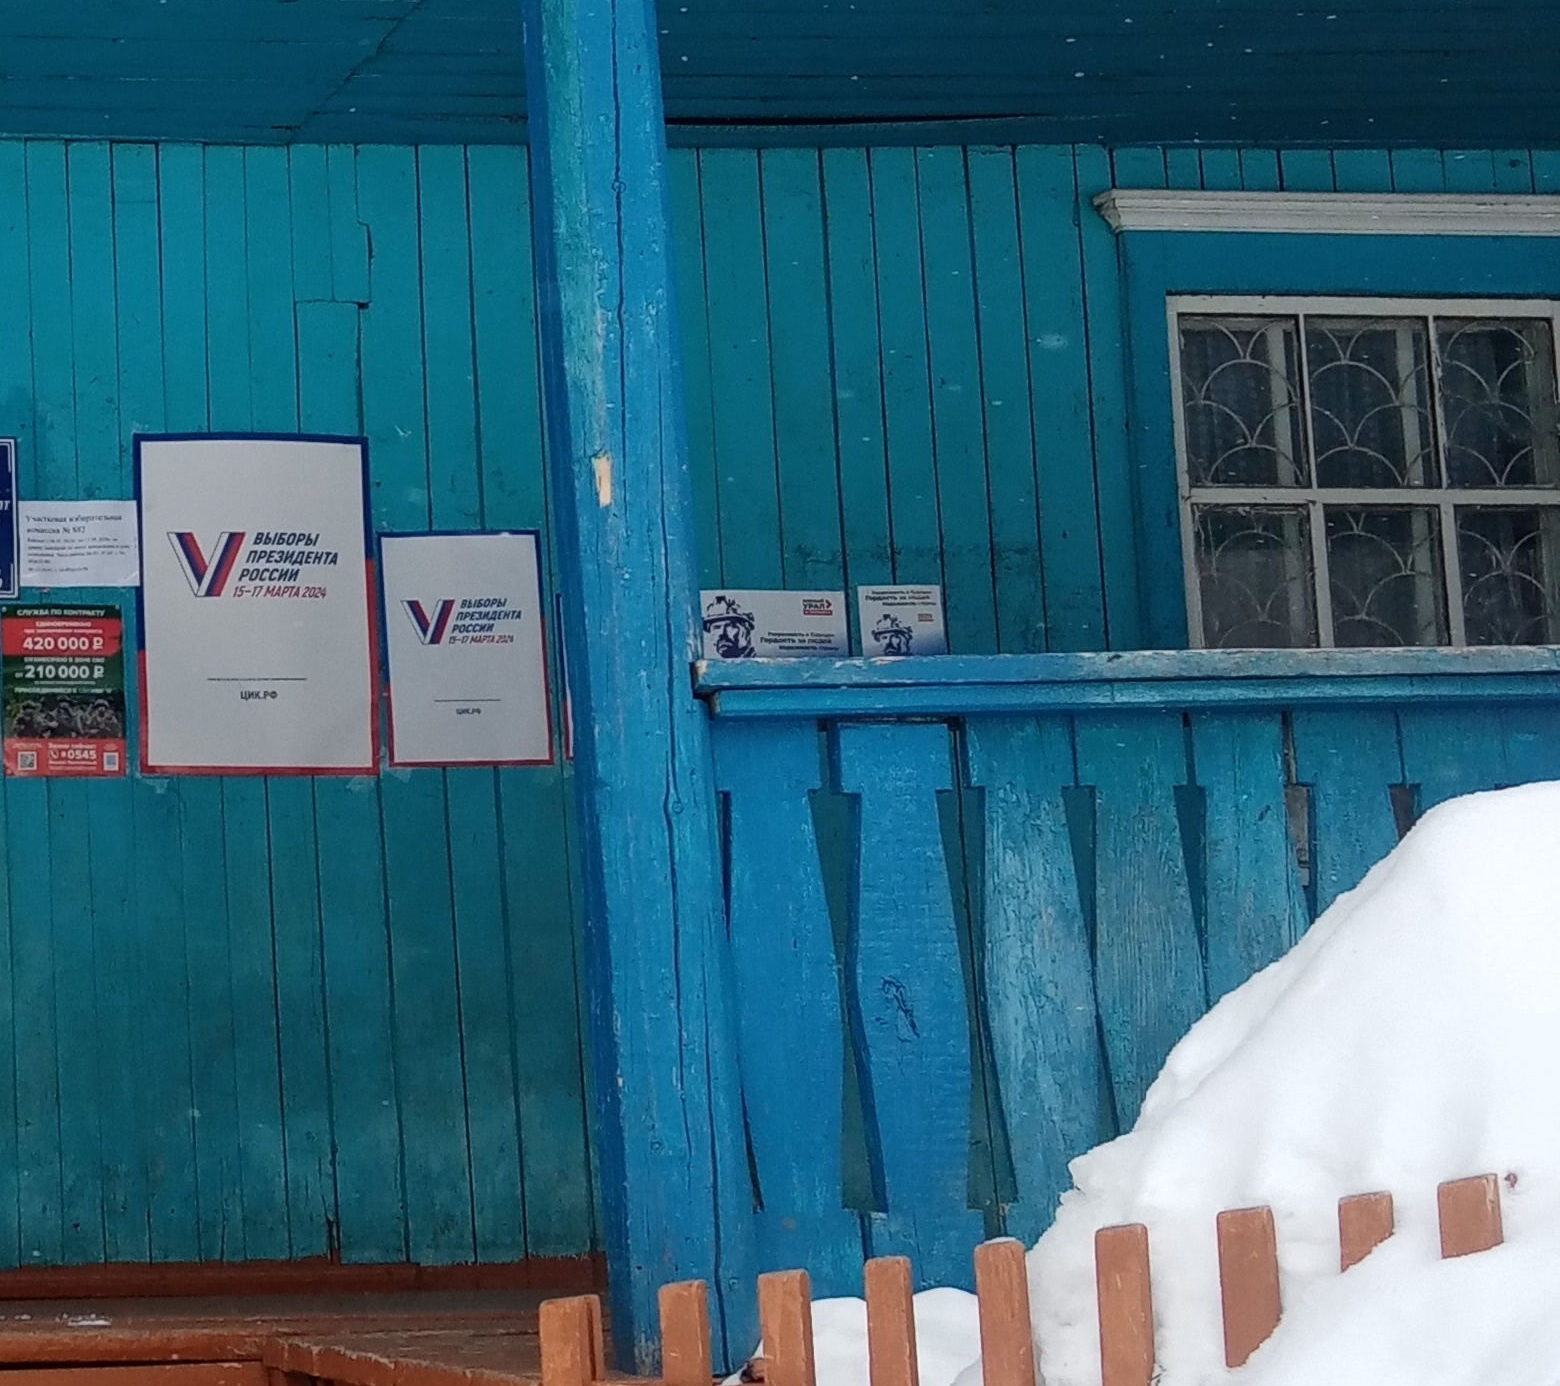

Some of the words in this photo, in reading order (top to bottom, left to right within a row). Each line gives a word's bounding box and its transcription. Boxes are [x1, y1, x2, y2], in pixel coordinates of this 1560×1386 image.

[253, 531, 320, 547] ВЫБОРЫ
[245, 550, 339, 566] ПРЕЗИДЕНТА
[238, 568, 300, 582] РОССИИ
[264, 586, 300, 598] МАРТА
[301, 586, 327, 599] 2024
[460, 598, 507, 609] ВЫБОРЫ
[456, 610, 522, 621] ПРЕЗИДЕНТА
[452, 623, 495, 633] РОССИИ
[23, 636, 55, 650] 420
[57, 636, 89, 650] 000
[25, 665, 56, 679] 210
[58, 665, 90, 679] 000
[239, 690, 278, 700] ЦИК.РФ
